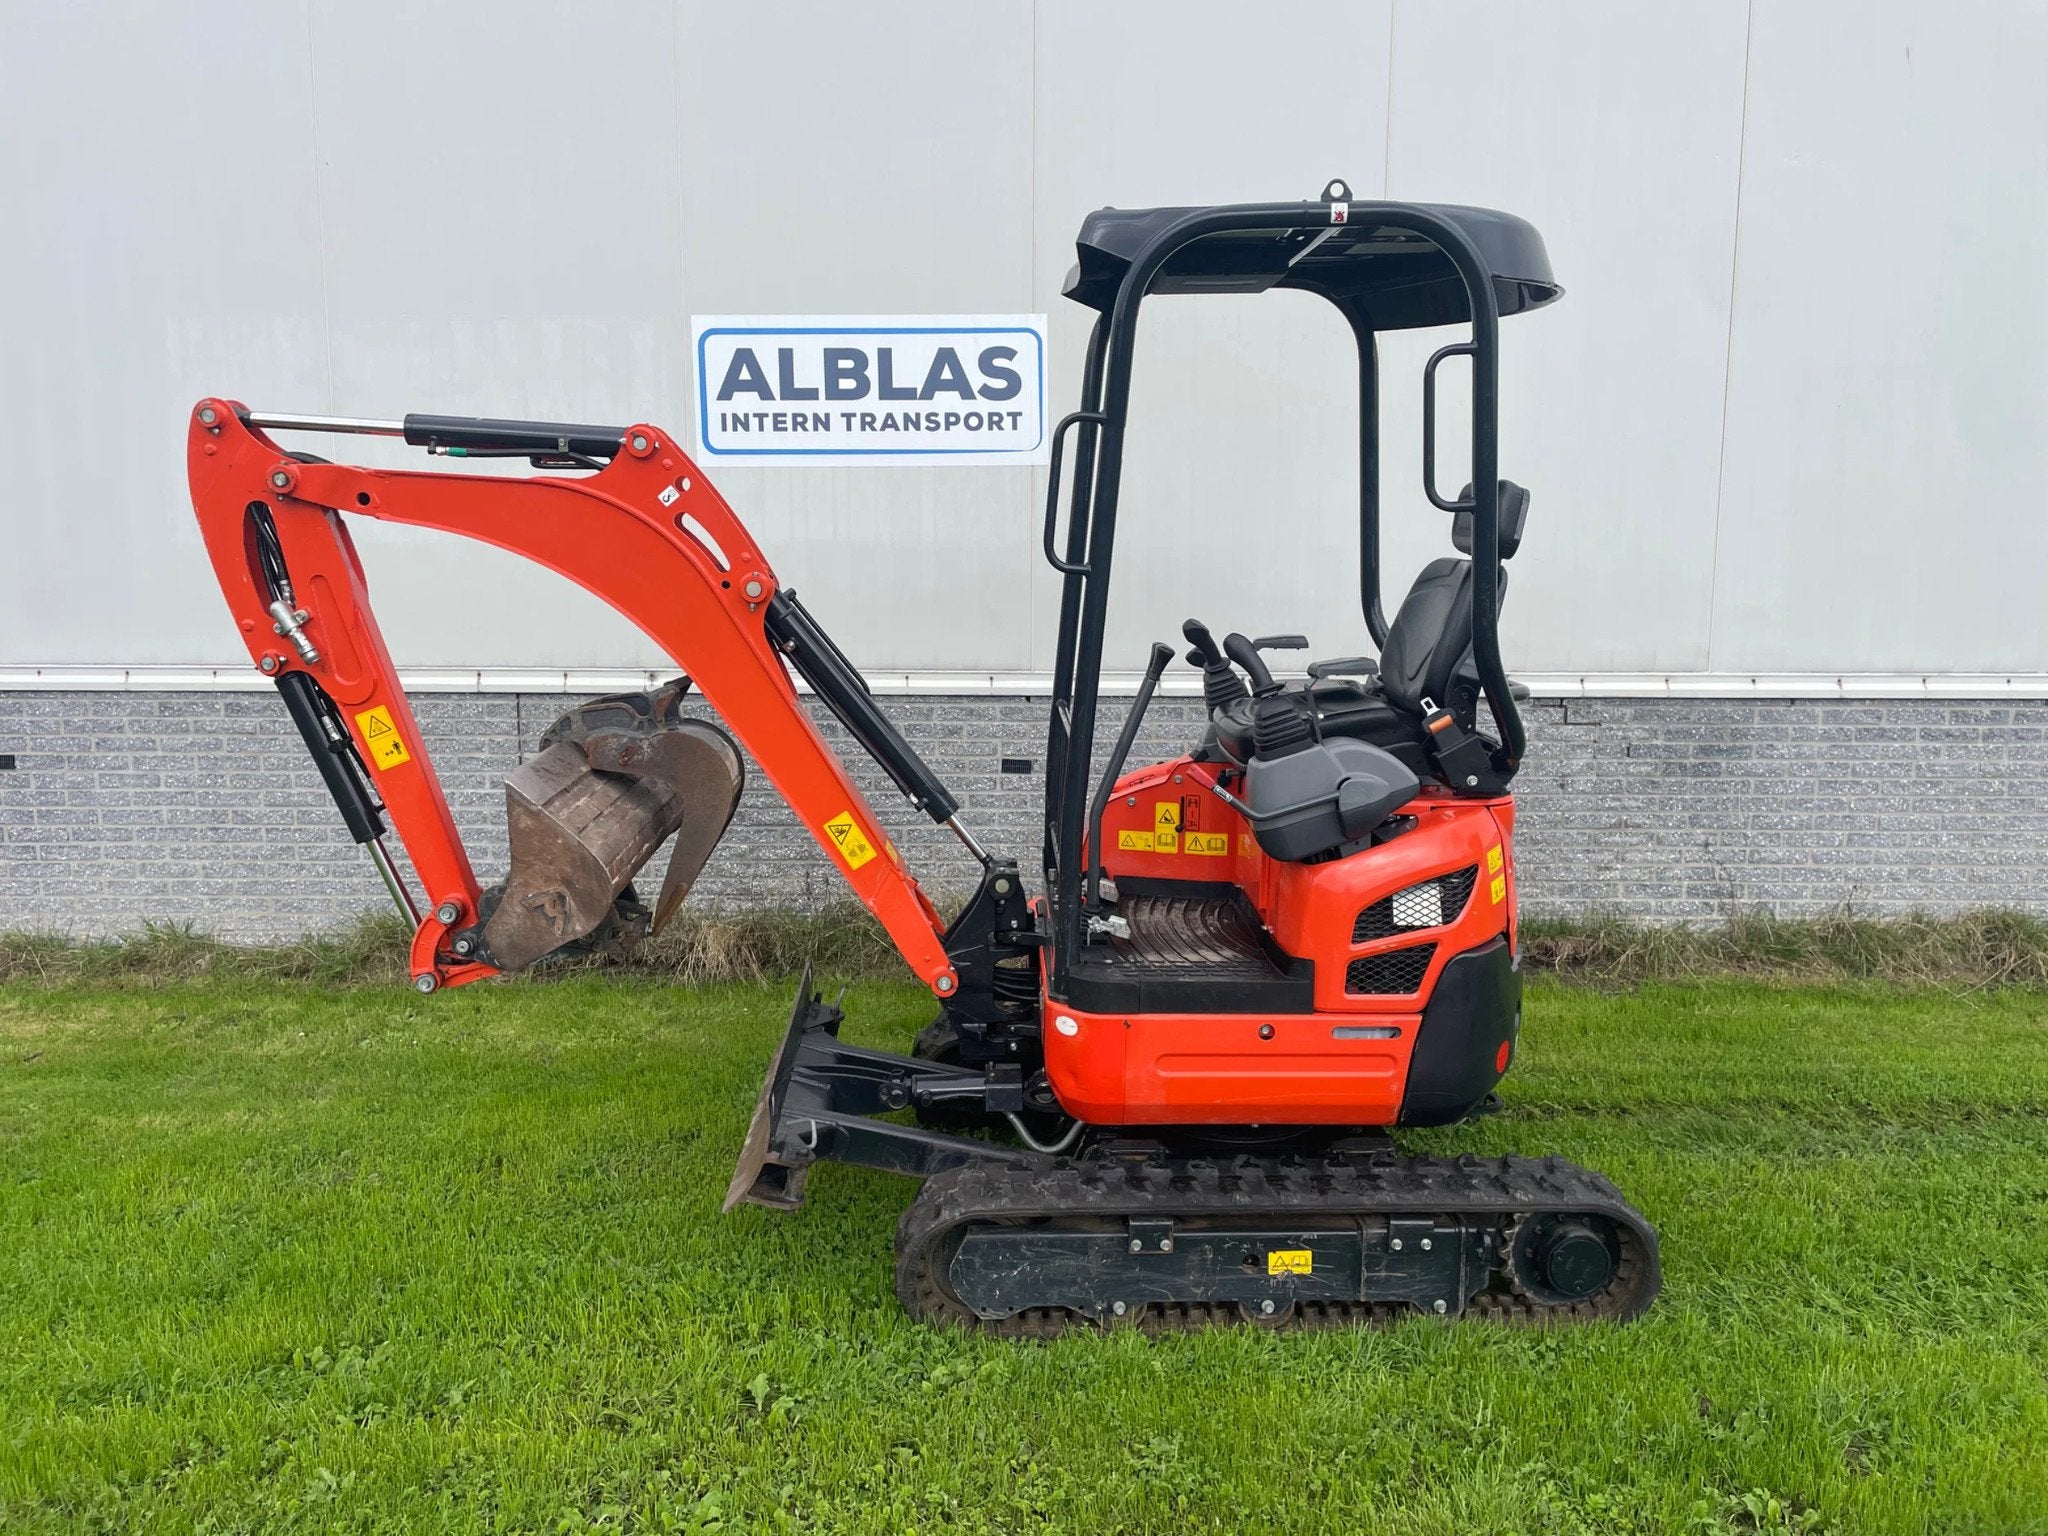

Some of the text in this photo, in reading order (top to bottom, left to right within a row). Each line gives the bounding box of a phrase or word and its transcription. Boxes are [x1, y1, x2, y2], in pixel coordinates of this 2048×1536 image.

[716, 346, 1022, 401] ALBLAS
[720, 411, 1023, 432] INTERN TRANSPORT
